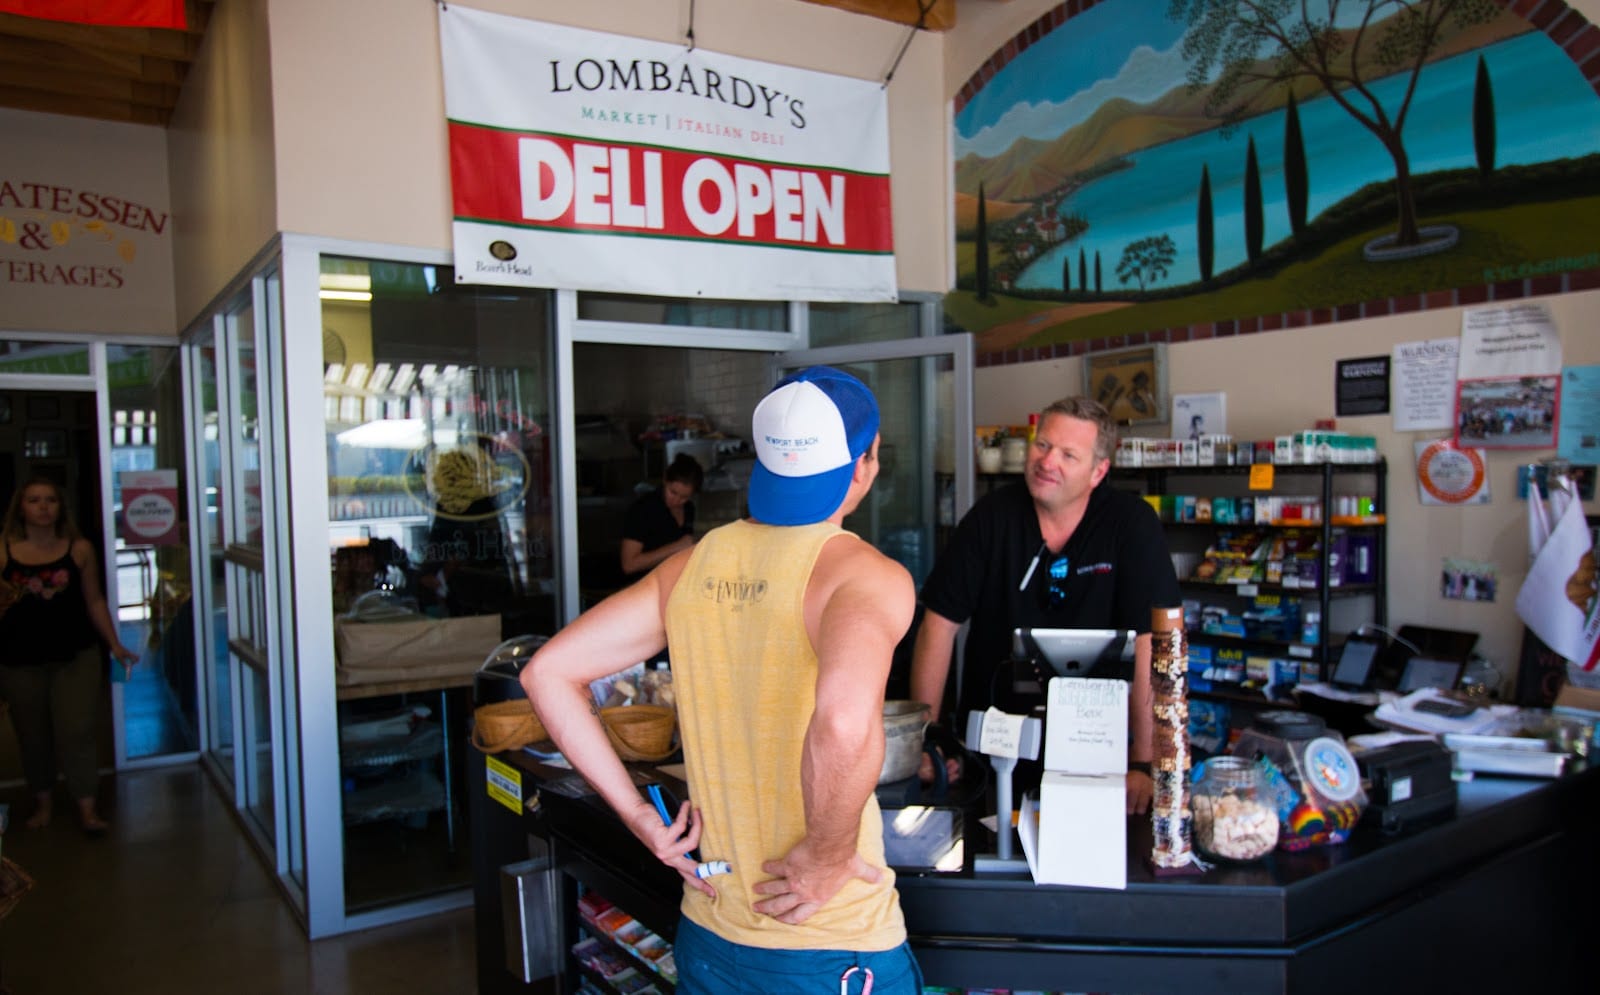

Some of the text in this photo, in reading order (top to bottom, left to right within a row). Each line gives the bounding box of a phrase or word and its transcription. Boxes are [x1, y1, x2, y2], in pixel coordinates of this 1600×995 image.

[550, 59, 807, 129] LOMBARDY'S
[581, 106, 785, 146] MARKET ITALIAN DELI
[0, 181, 168, 235] ATESSEN
[518, 137, 846, 246] DELI OPEN
[19, 221, 51, 250] &
[0, 261, 124, 289] ERAGES
